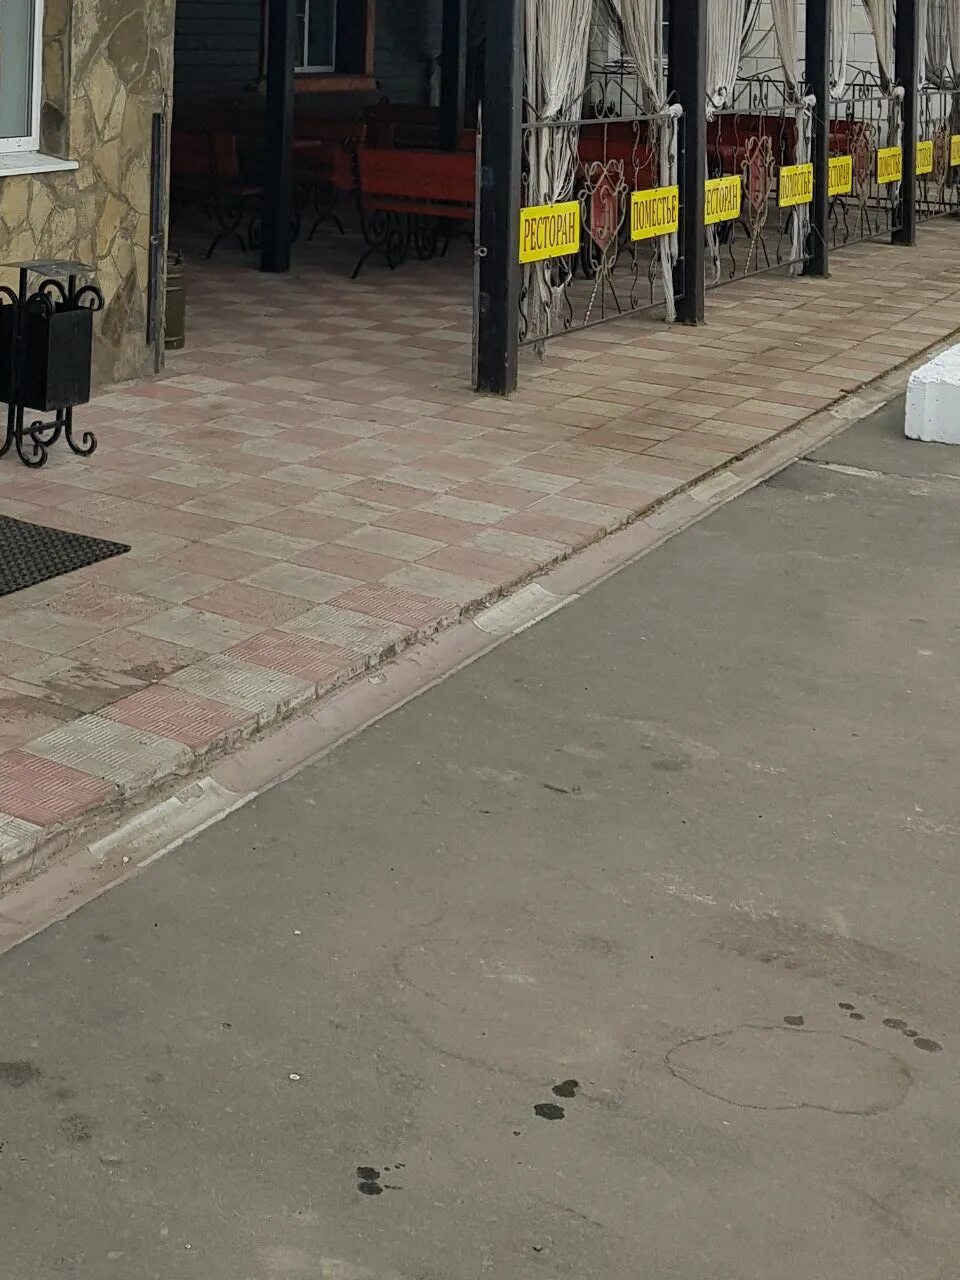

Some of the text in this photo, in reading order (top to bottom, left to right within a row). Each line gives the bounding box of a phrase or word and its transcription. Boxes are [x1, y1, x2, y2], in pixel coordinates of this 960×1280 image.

[705, 183, 738, 216] ЕСТОРАН
[780, 170, 811, 200] ПОМЕСТЬЕ
[632, 194, 677, 231] ПОМЕСТЬЕ
[523, 211, 576, 252] РЕСТОРАН
